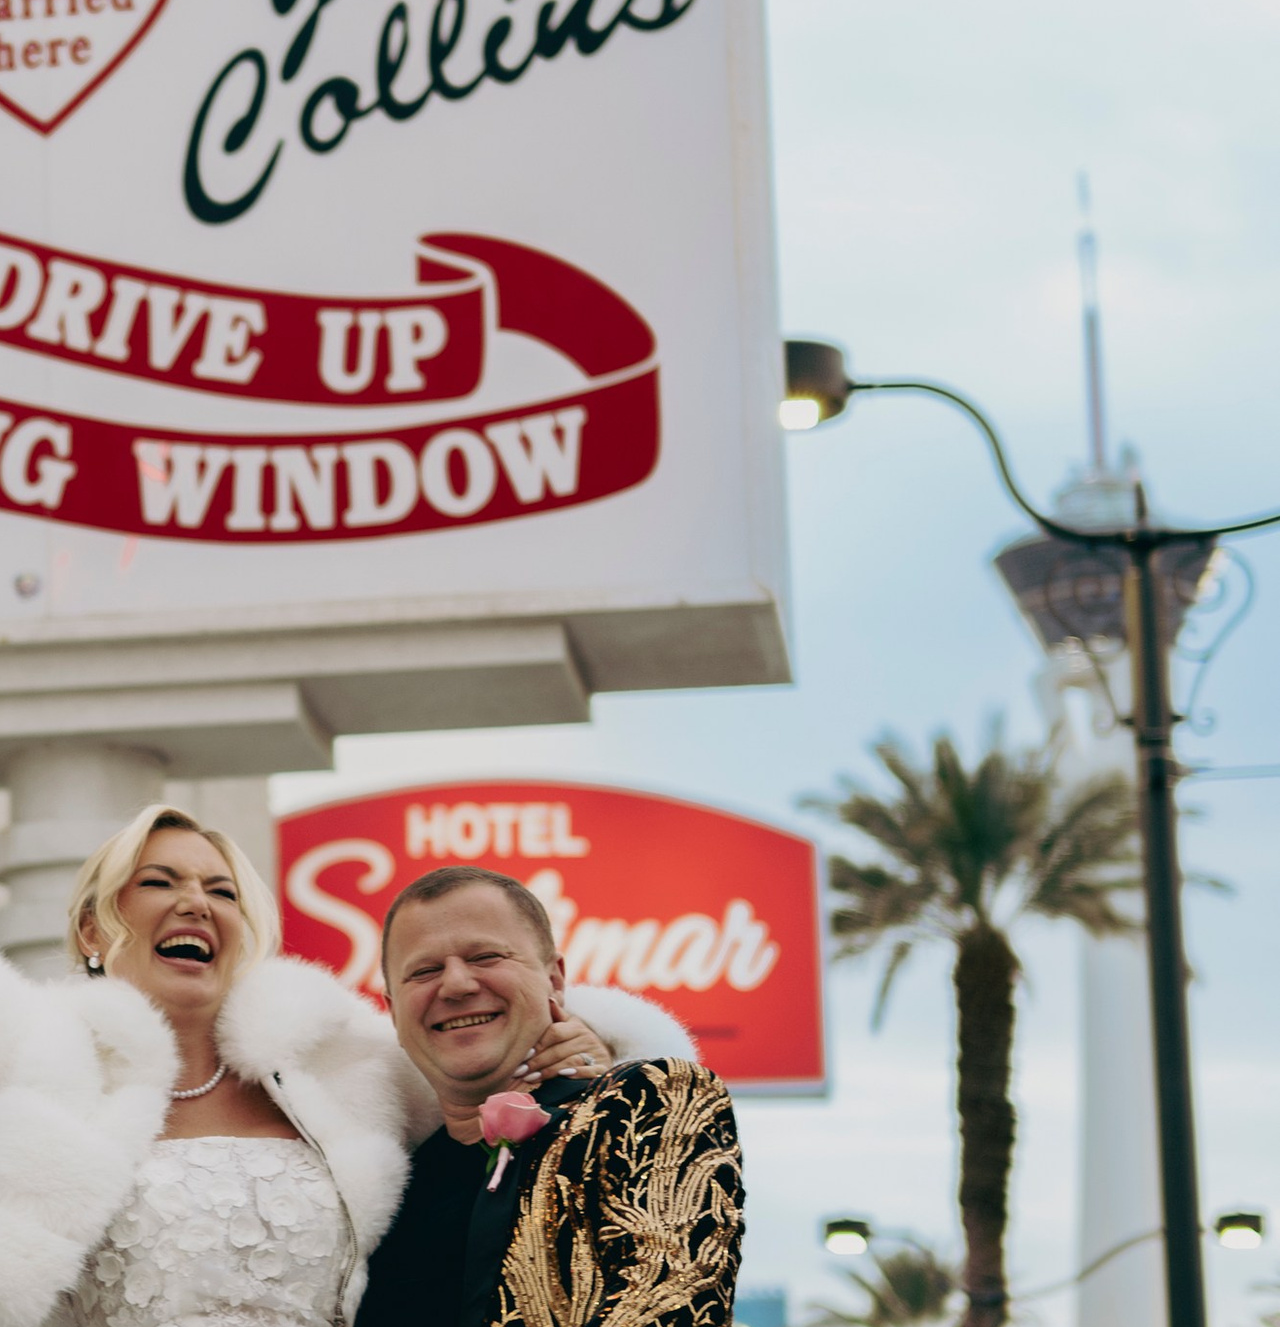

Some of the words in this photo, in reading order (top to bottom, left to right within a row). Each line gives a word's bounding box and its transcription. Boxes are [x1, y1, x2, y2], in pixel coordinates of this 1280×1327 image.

[317, 304, 450, 395] UP
[133, 404, 589, 533] WINDOW
[404, 800, 592, 860] HOTEL
